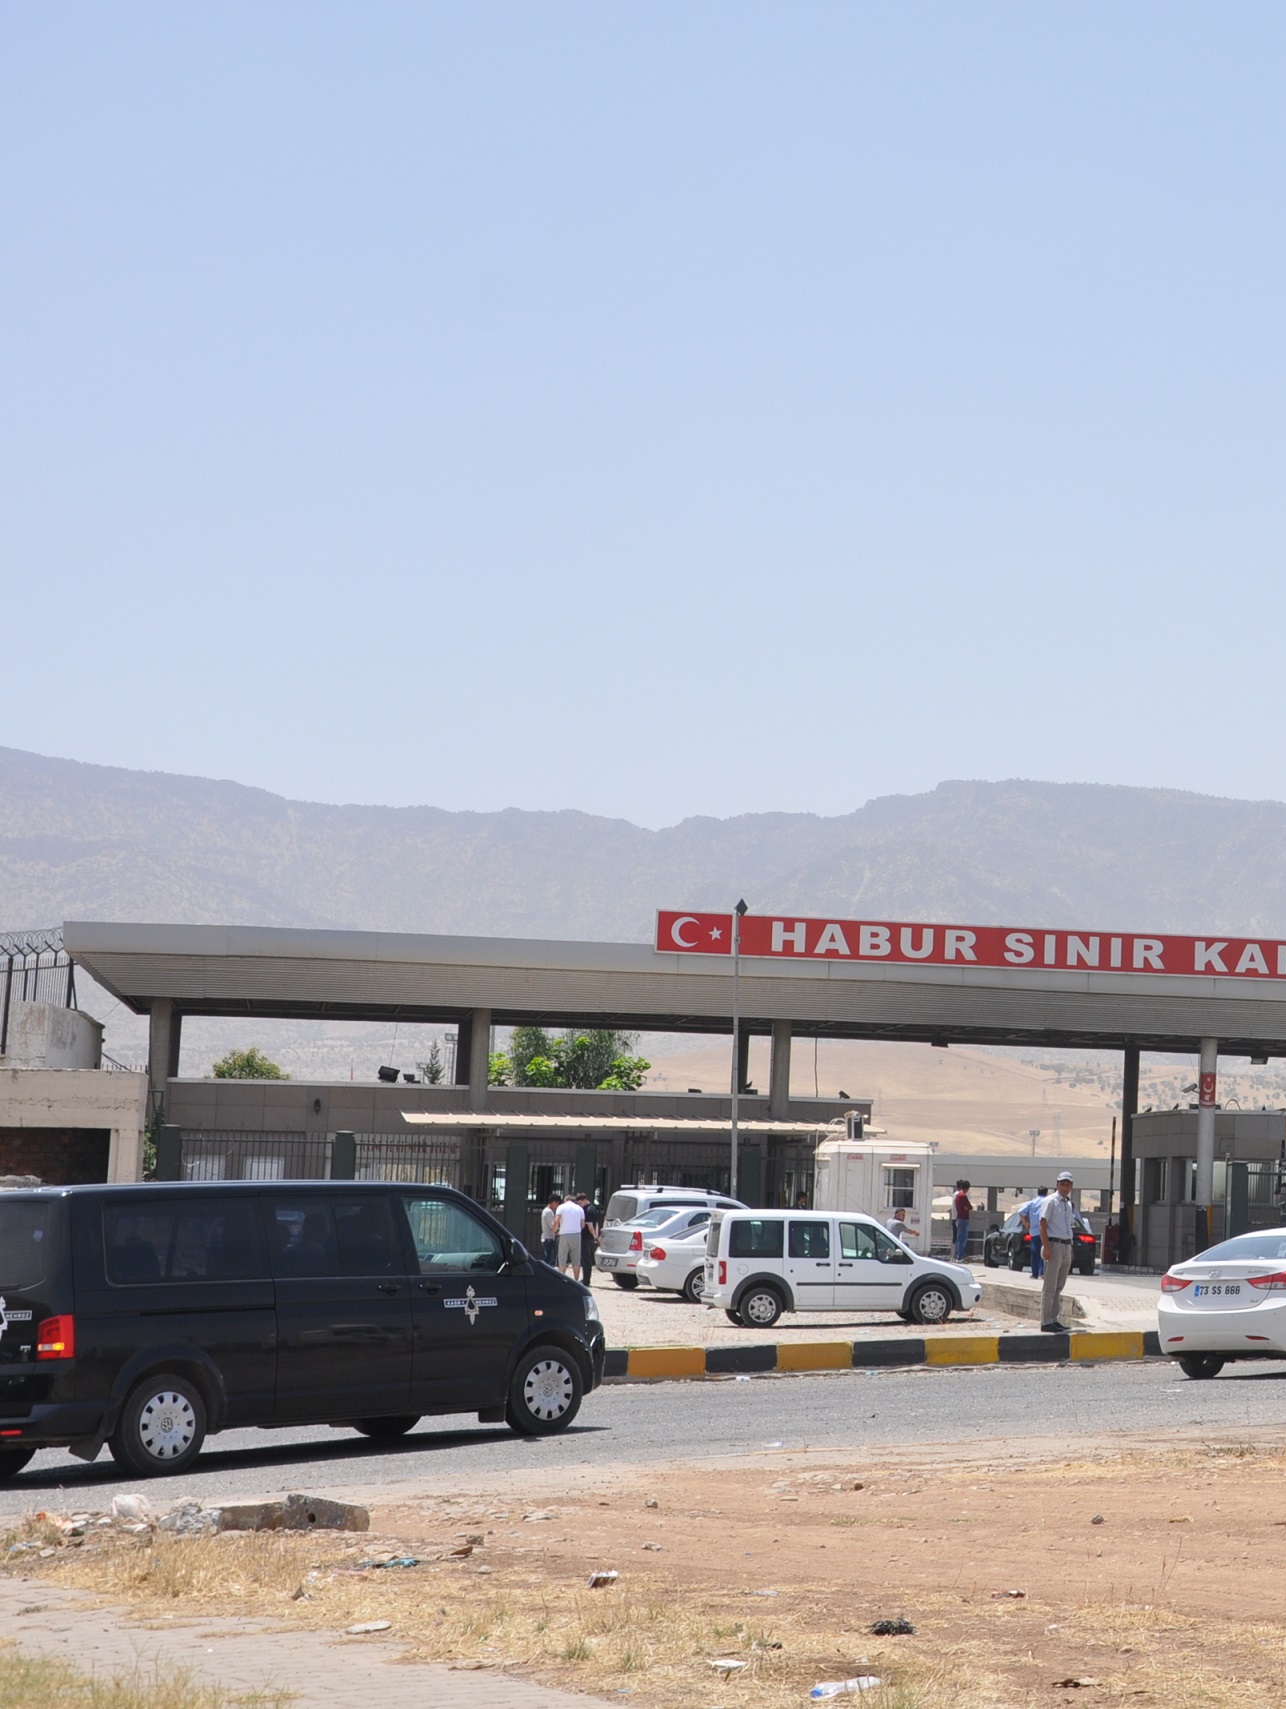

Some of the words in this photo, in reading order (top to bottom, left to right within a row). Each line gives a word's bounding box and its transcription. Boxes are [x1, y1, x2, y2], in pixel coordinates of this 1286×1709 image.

[770, 920, 978, 962] HABUR
[1003, 932, 1166, 970] SINIR
[1200, 1286, 1209, 1295] 73
[1212, 1286, 1222, 1295] SS
